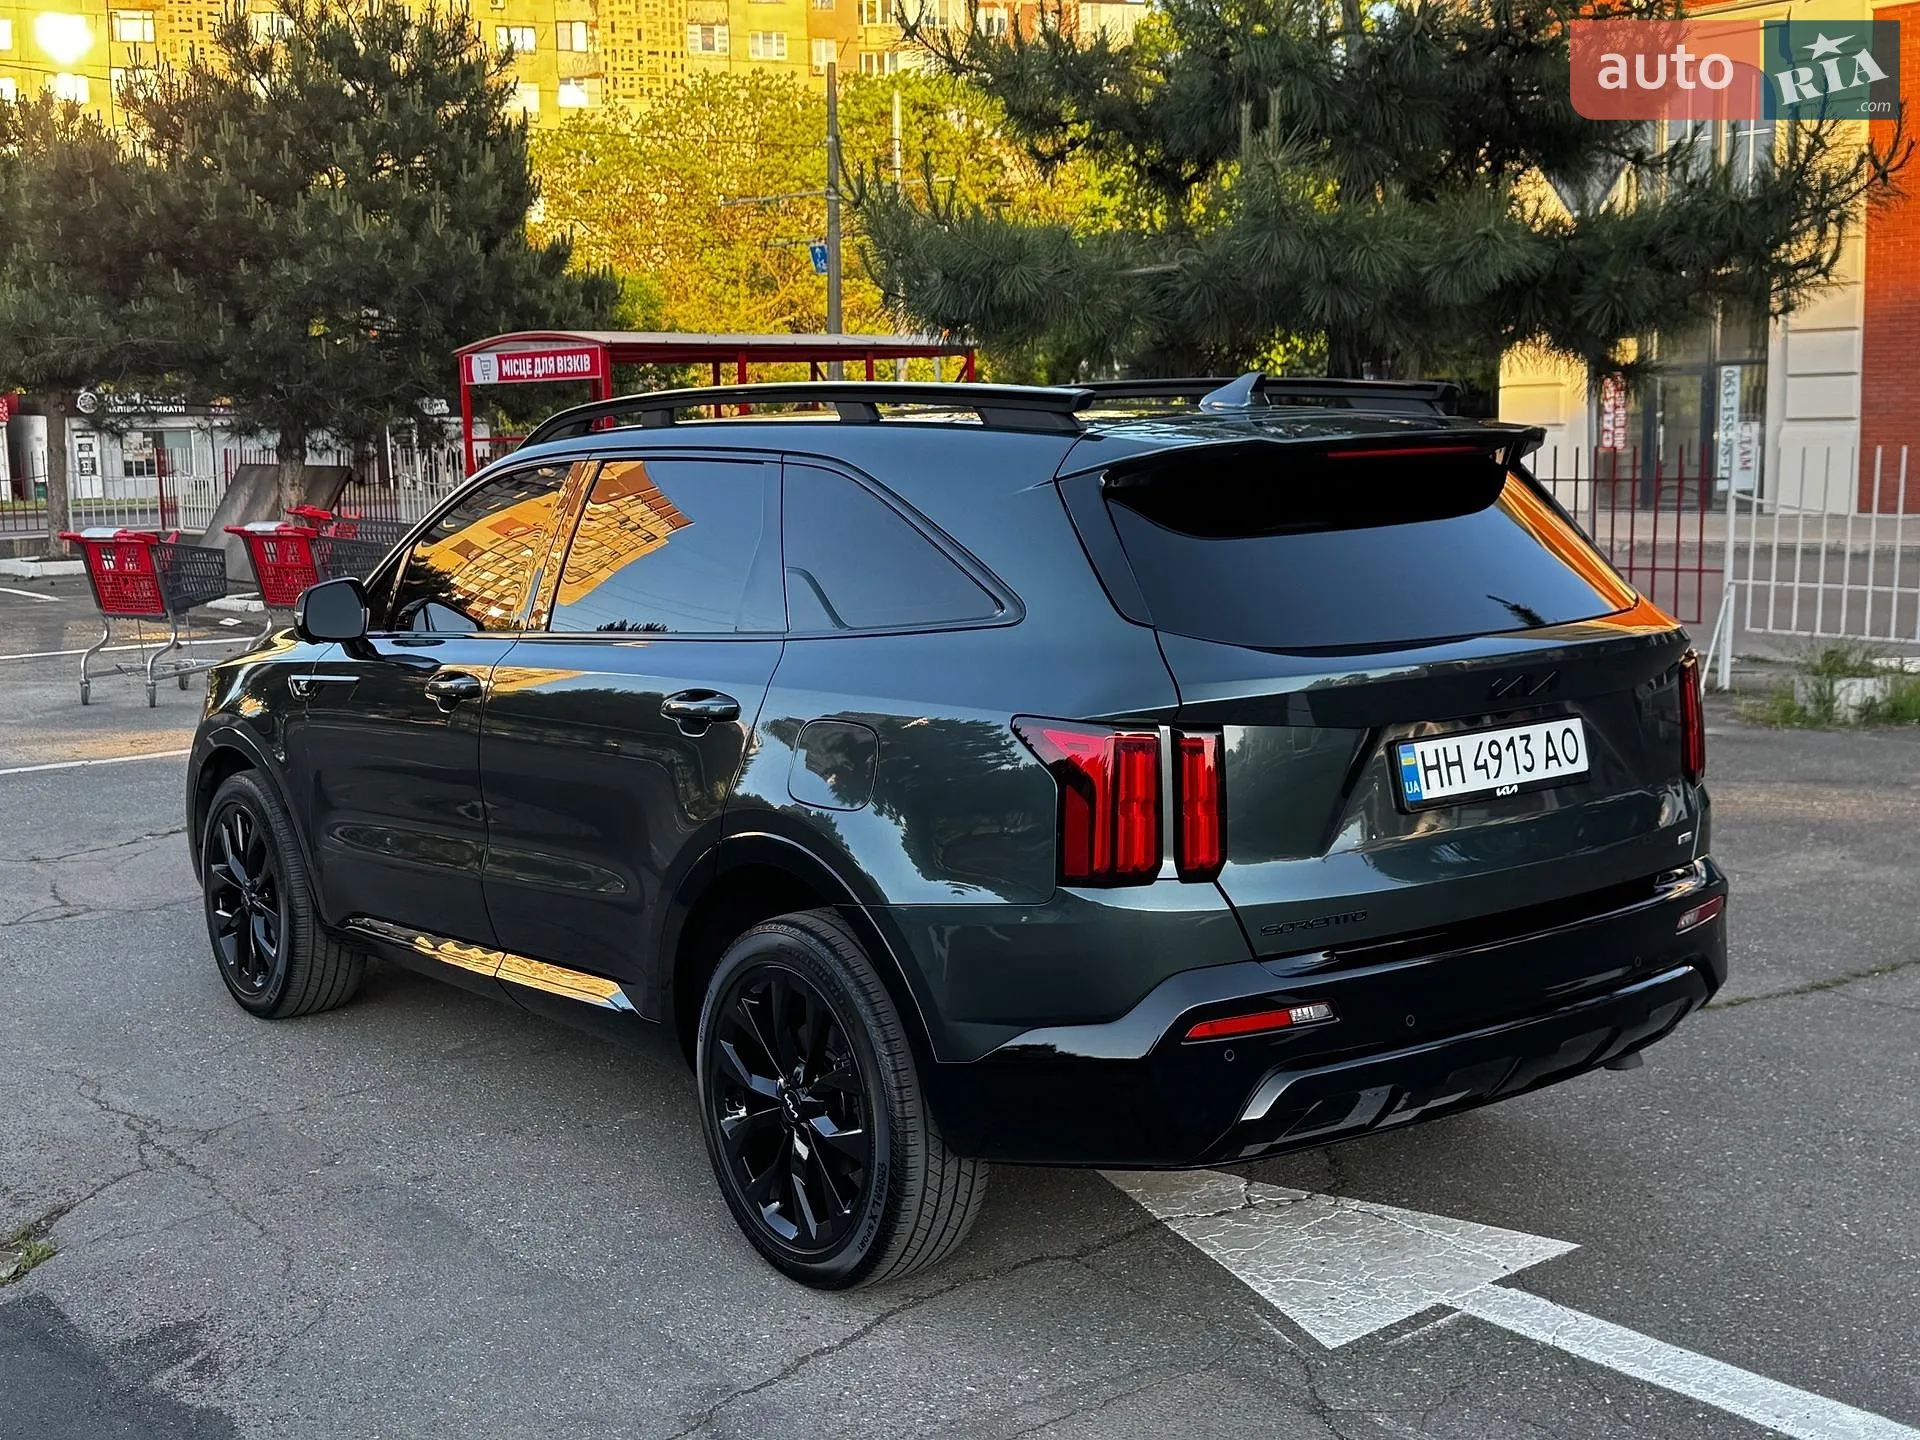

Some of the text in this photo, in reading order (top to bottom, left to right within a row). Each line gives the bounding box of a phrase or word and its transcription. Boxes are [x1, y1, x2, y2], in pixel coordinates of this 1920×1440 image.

[502, 353, 591, 378] МІСЦЕ ДЛЯ ВІЗКІВ
[1420, 727, 1579, 790] HH 4913 AO
[1405, 781, 1421, 794] UA
